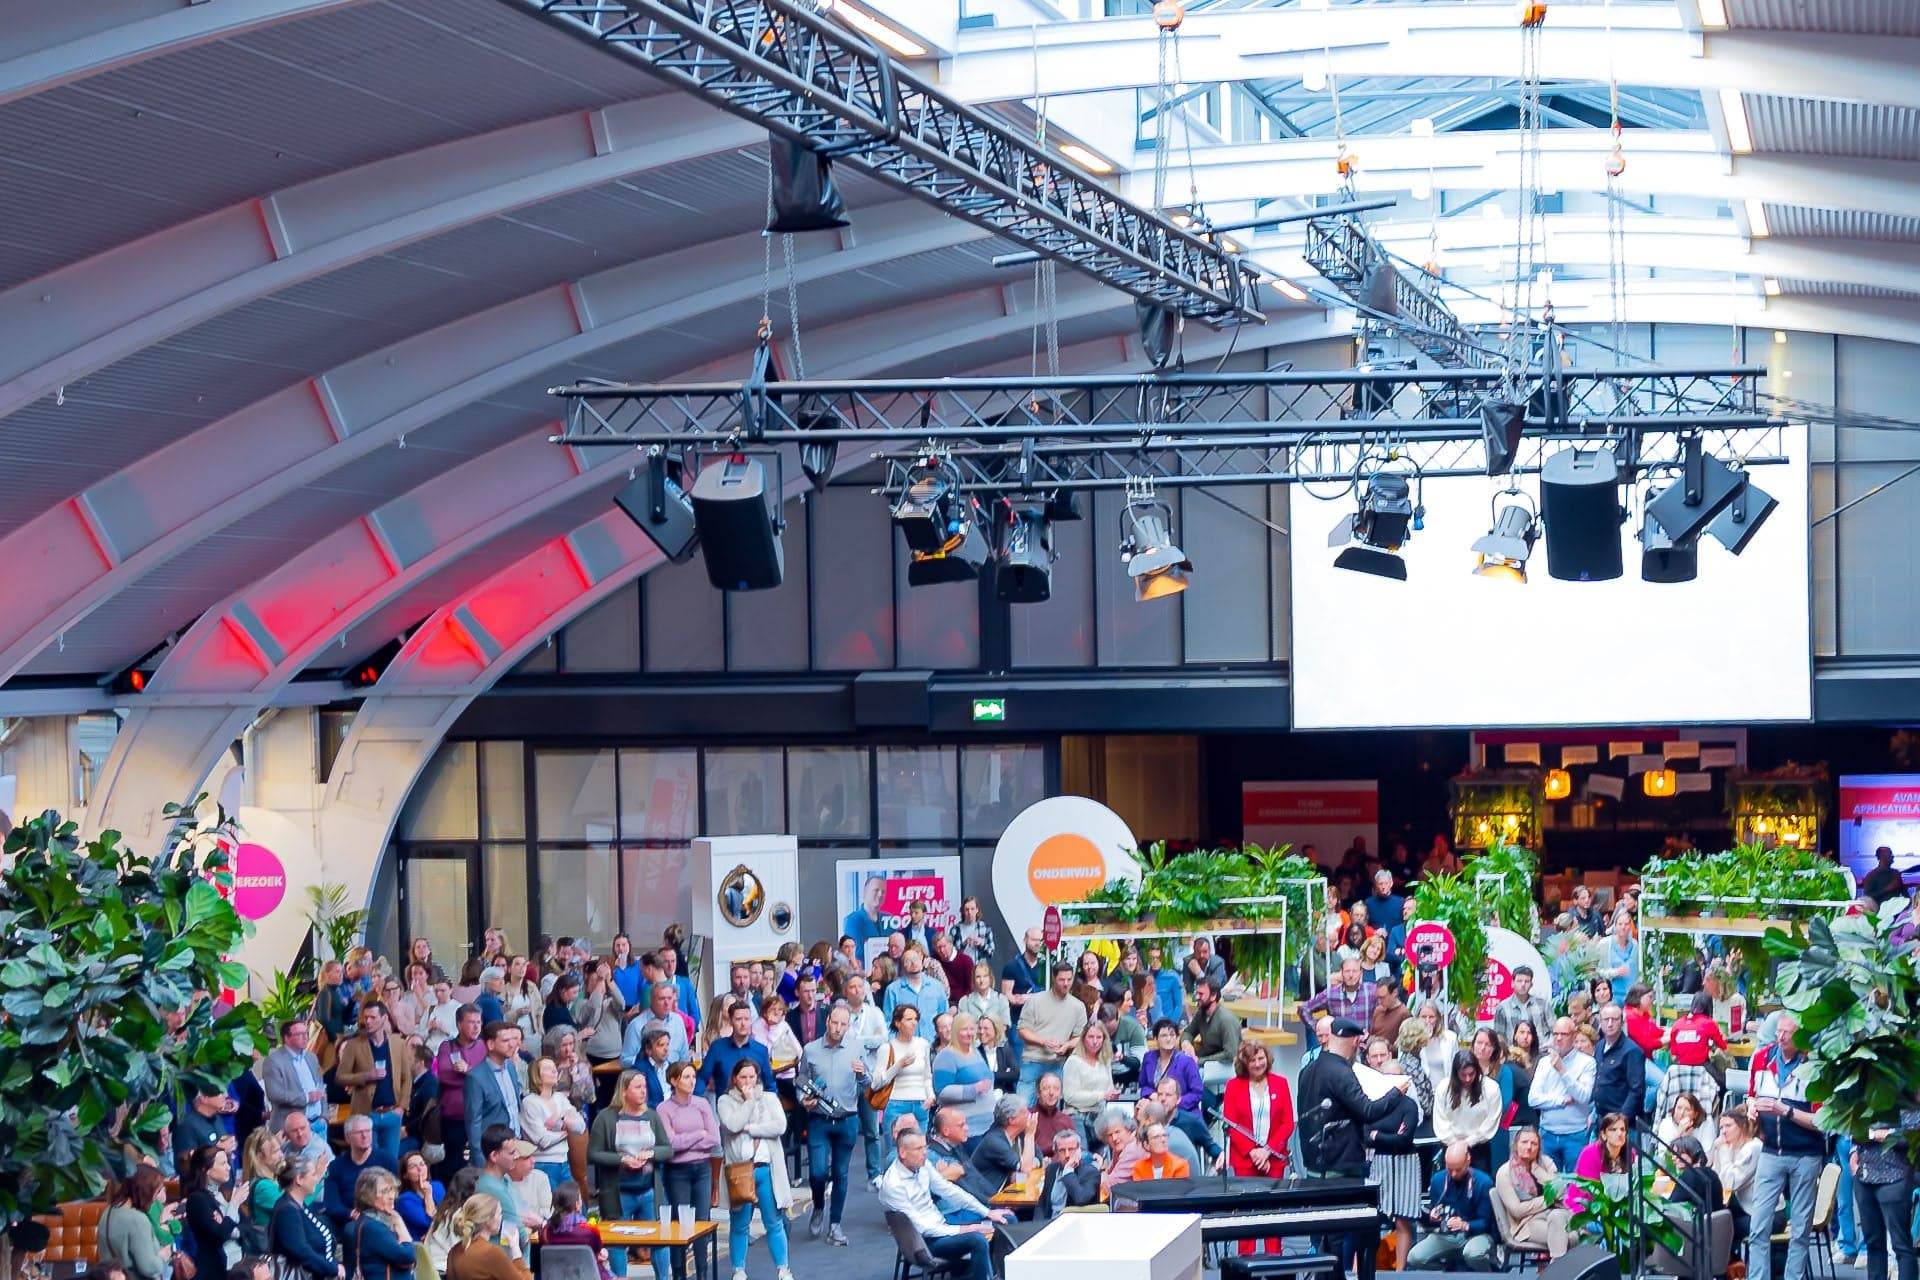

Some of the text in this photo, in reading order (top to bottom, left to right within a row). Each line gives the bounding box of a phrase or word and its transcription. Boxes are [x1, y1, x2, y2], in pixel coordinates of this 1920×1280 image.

[1033, 867, 1101, 879] ONDERWIJS
[898, 885, 935, 901] LET'S
[900, 899, 951, 915] AANS
[1416, 932, 1443, 943] OPEN
